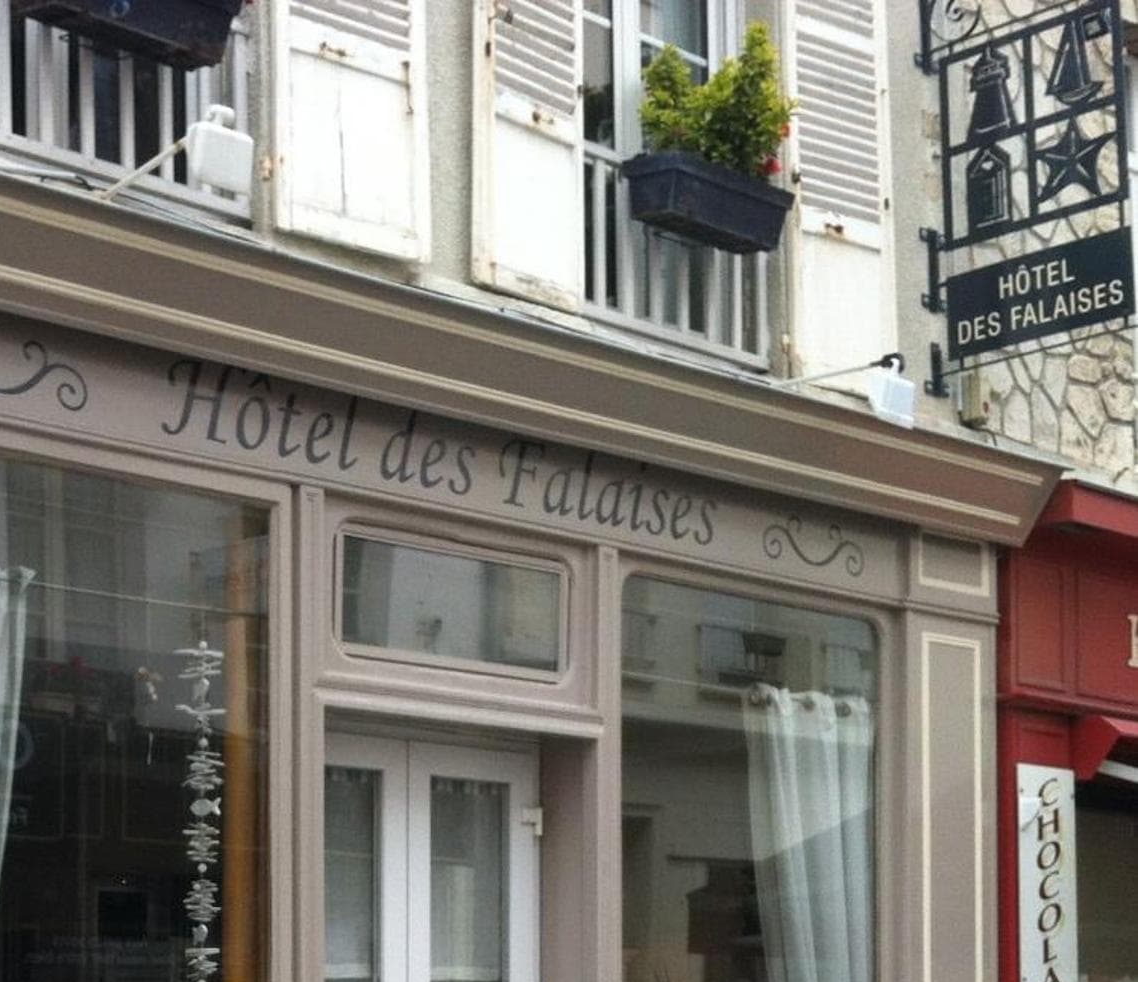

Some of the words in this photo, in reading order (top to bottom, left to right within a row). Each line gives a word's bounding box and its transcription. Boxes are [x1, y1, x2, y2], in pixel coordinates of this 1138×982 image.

[957, 310, 1003, 346] DES
[1010, 278, 1125, 332] FALAISES
[998, 258, 1076, 300] HÔTEL
[162, 359, 360, 471] Hôtel
[379, 409, 476, 496] des
[499, 439, 719, 547] Falaises
